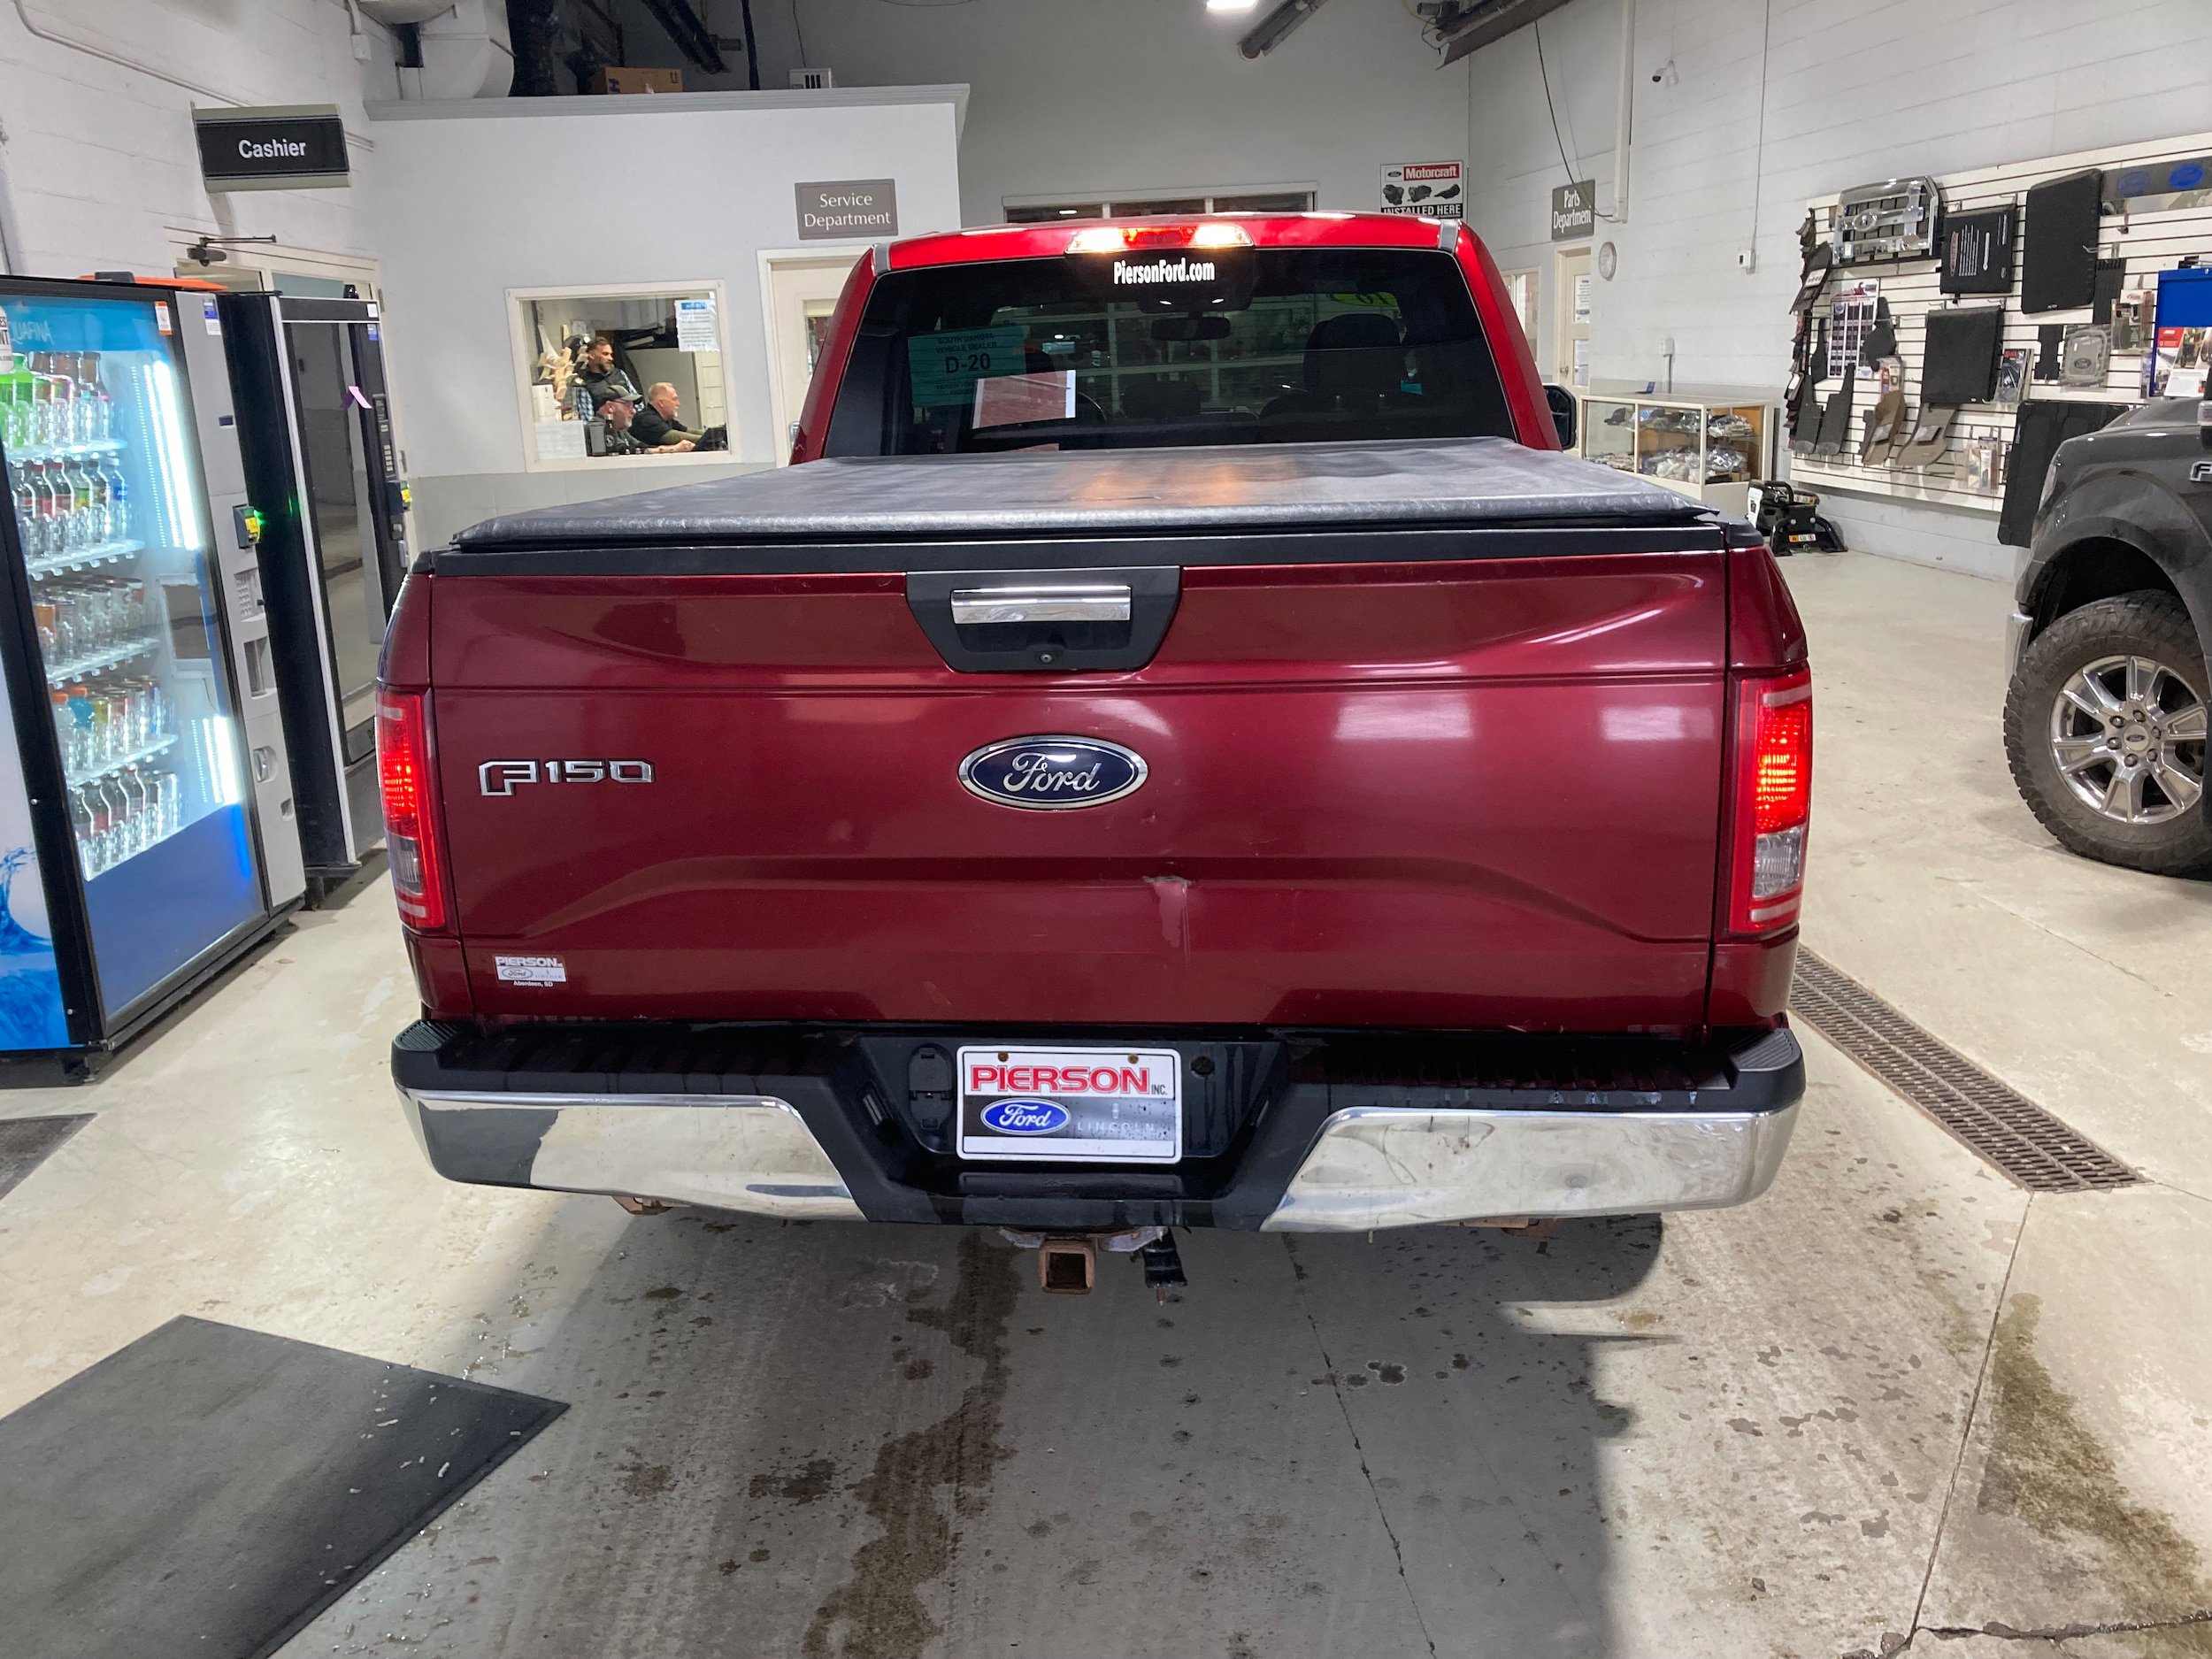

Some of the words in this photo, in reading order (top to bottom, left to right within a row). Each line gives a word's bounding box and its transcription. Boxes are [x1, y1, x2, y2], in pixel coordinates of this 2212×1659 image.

[238, 138, 306, 158] Cashier
[1406, 165, 1457, 179] Motorcraft
[819, 193, 872, 208] Service
[1564, 189, 1580, 208] Parts
[1437, 204, 1461, 215] HERE
[804, 212, 891, 231] Department
[1553, 208, 1592, 234] Department
[1113, 257, 1215, 284] PiersonFord.com
[945, 353, 990, 373] D-20
[1003, 752, 1102, 792] Ford
[495, 957, 557, 967] PIERSON
[971, 1064, 1150, 1094] PIERSON
[1151, 1085, 1168, 1095] INC.
[999, 1104, 1051, 1127] Ford
[1078, 1122, 1156, 1132] LINCOLN
